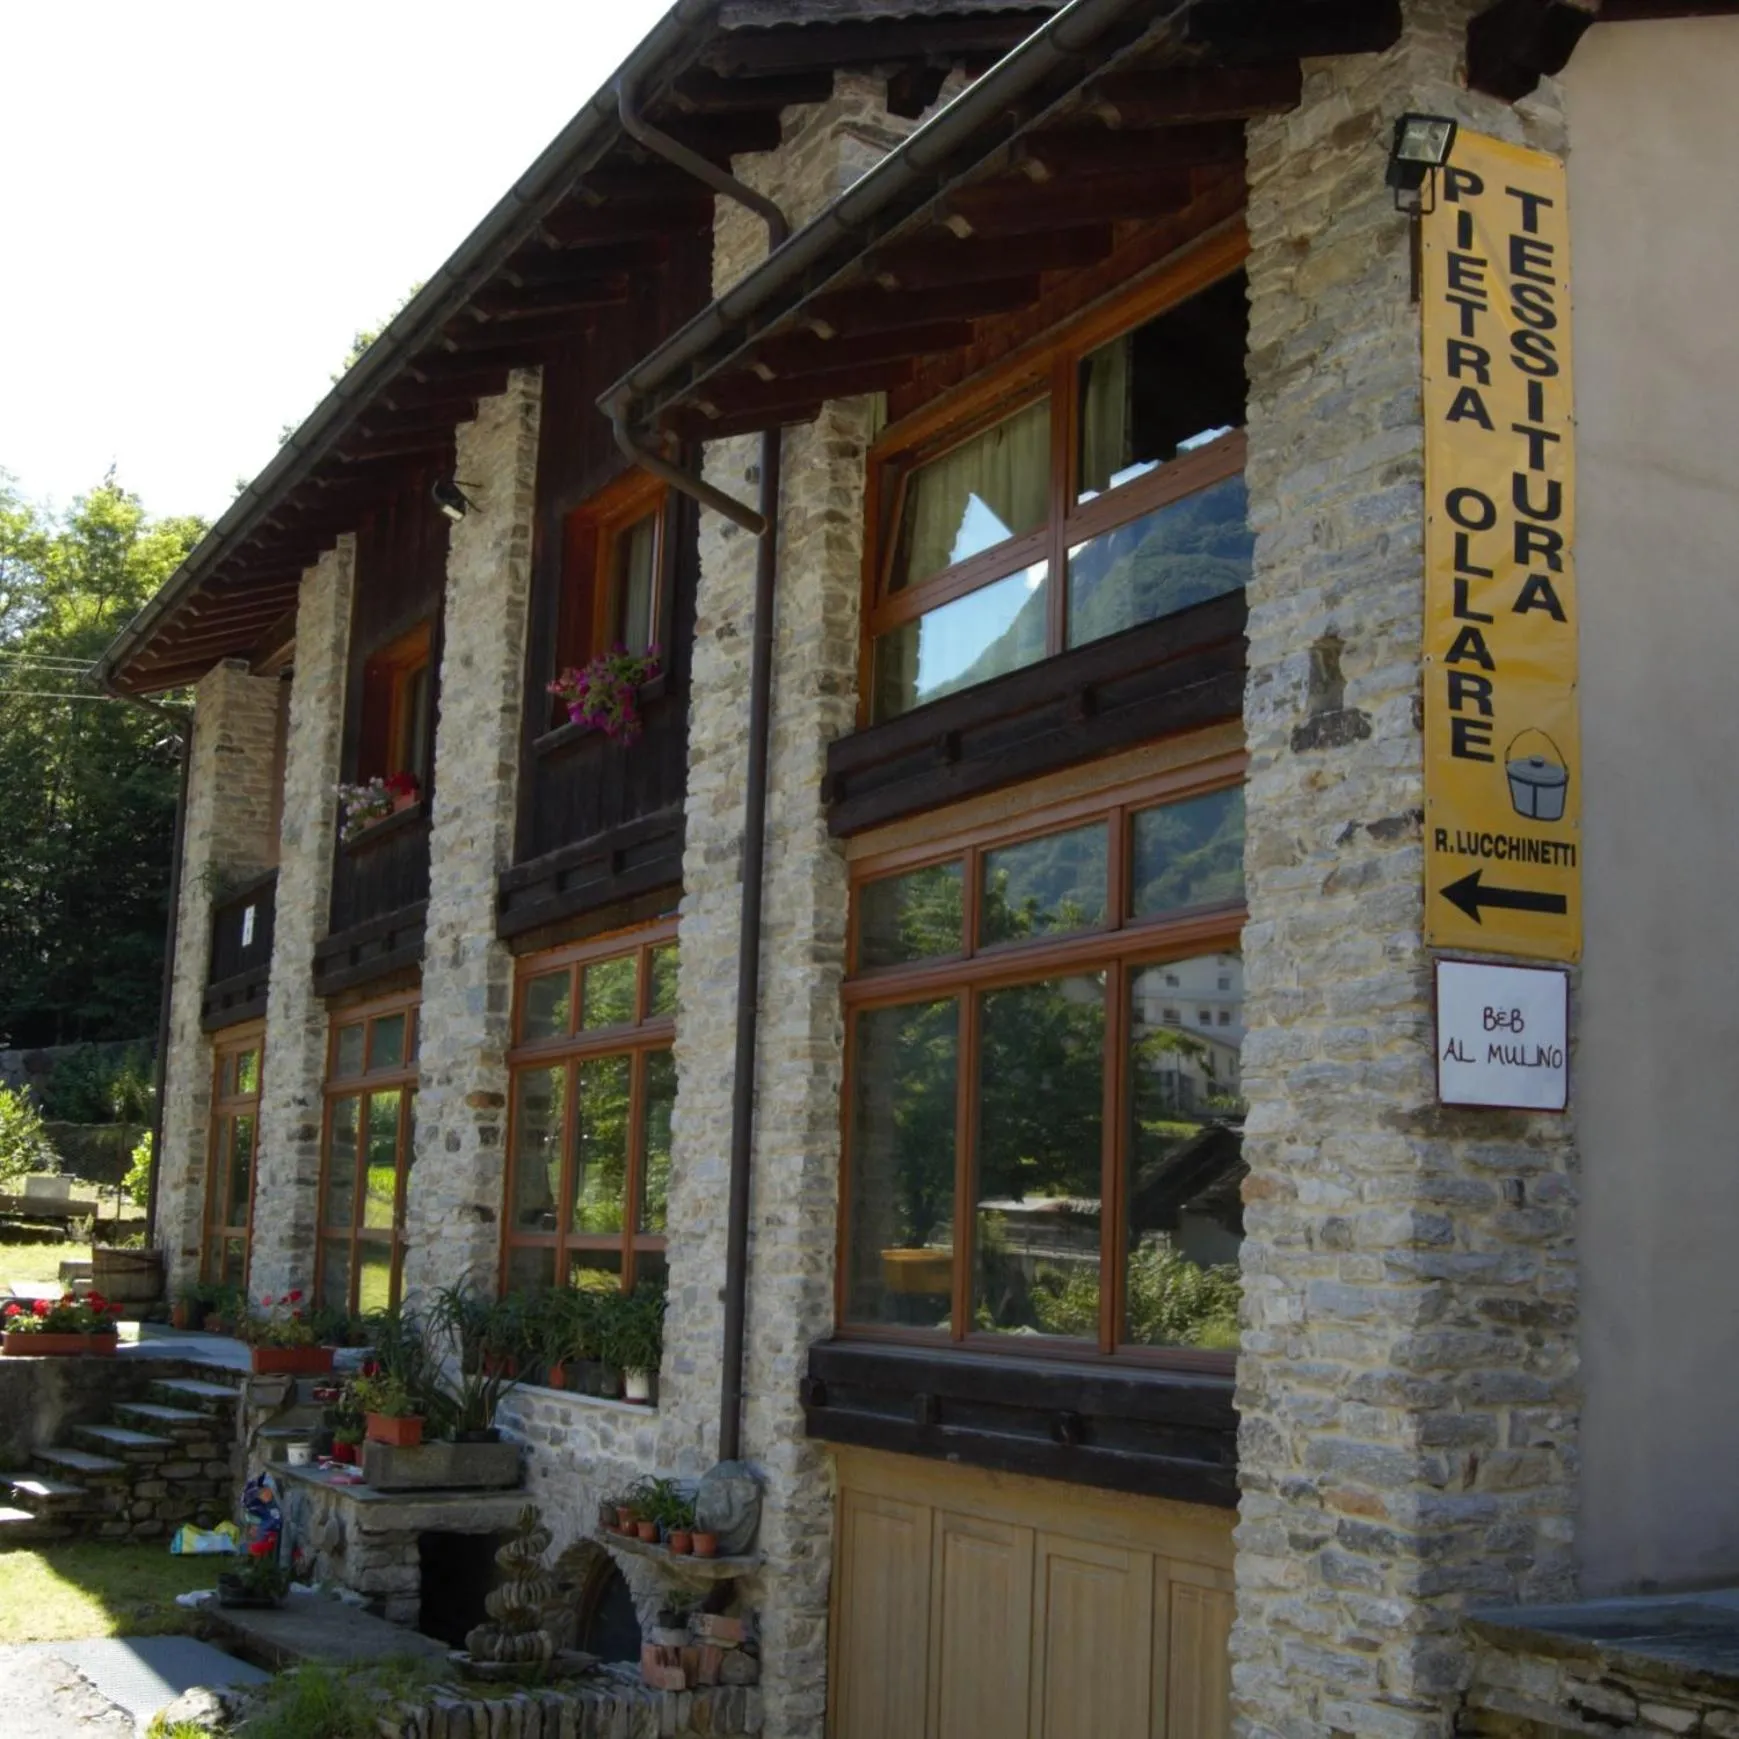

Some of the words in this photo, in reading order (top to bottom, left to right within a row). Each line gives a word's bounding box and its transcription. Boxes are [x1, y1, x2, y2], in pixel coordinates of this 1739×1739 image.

[1443, 165, 1495, 431] PIETRA
[1505, 185, 1568, 623] TESSITURA
[1444, 487, 1497, 763] OLLARE
[1443, 1037, 1476, 1063] AL
